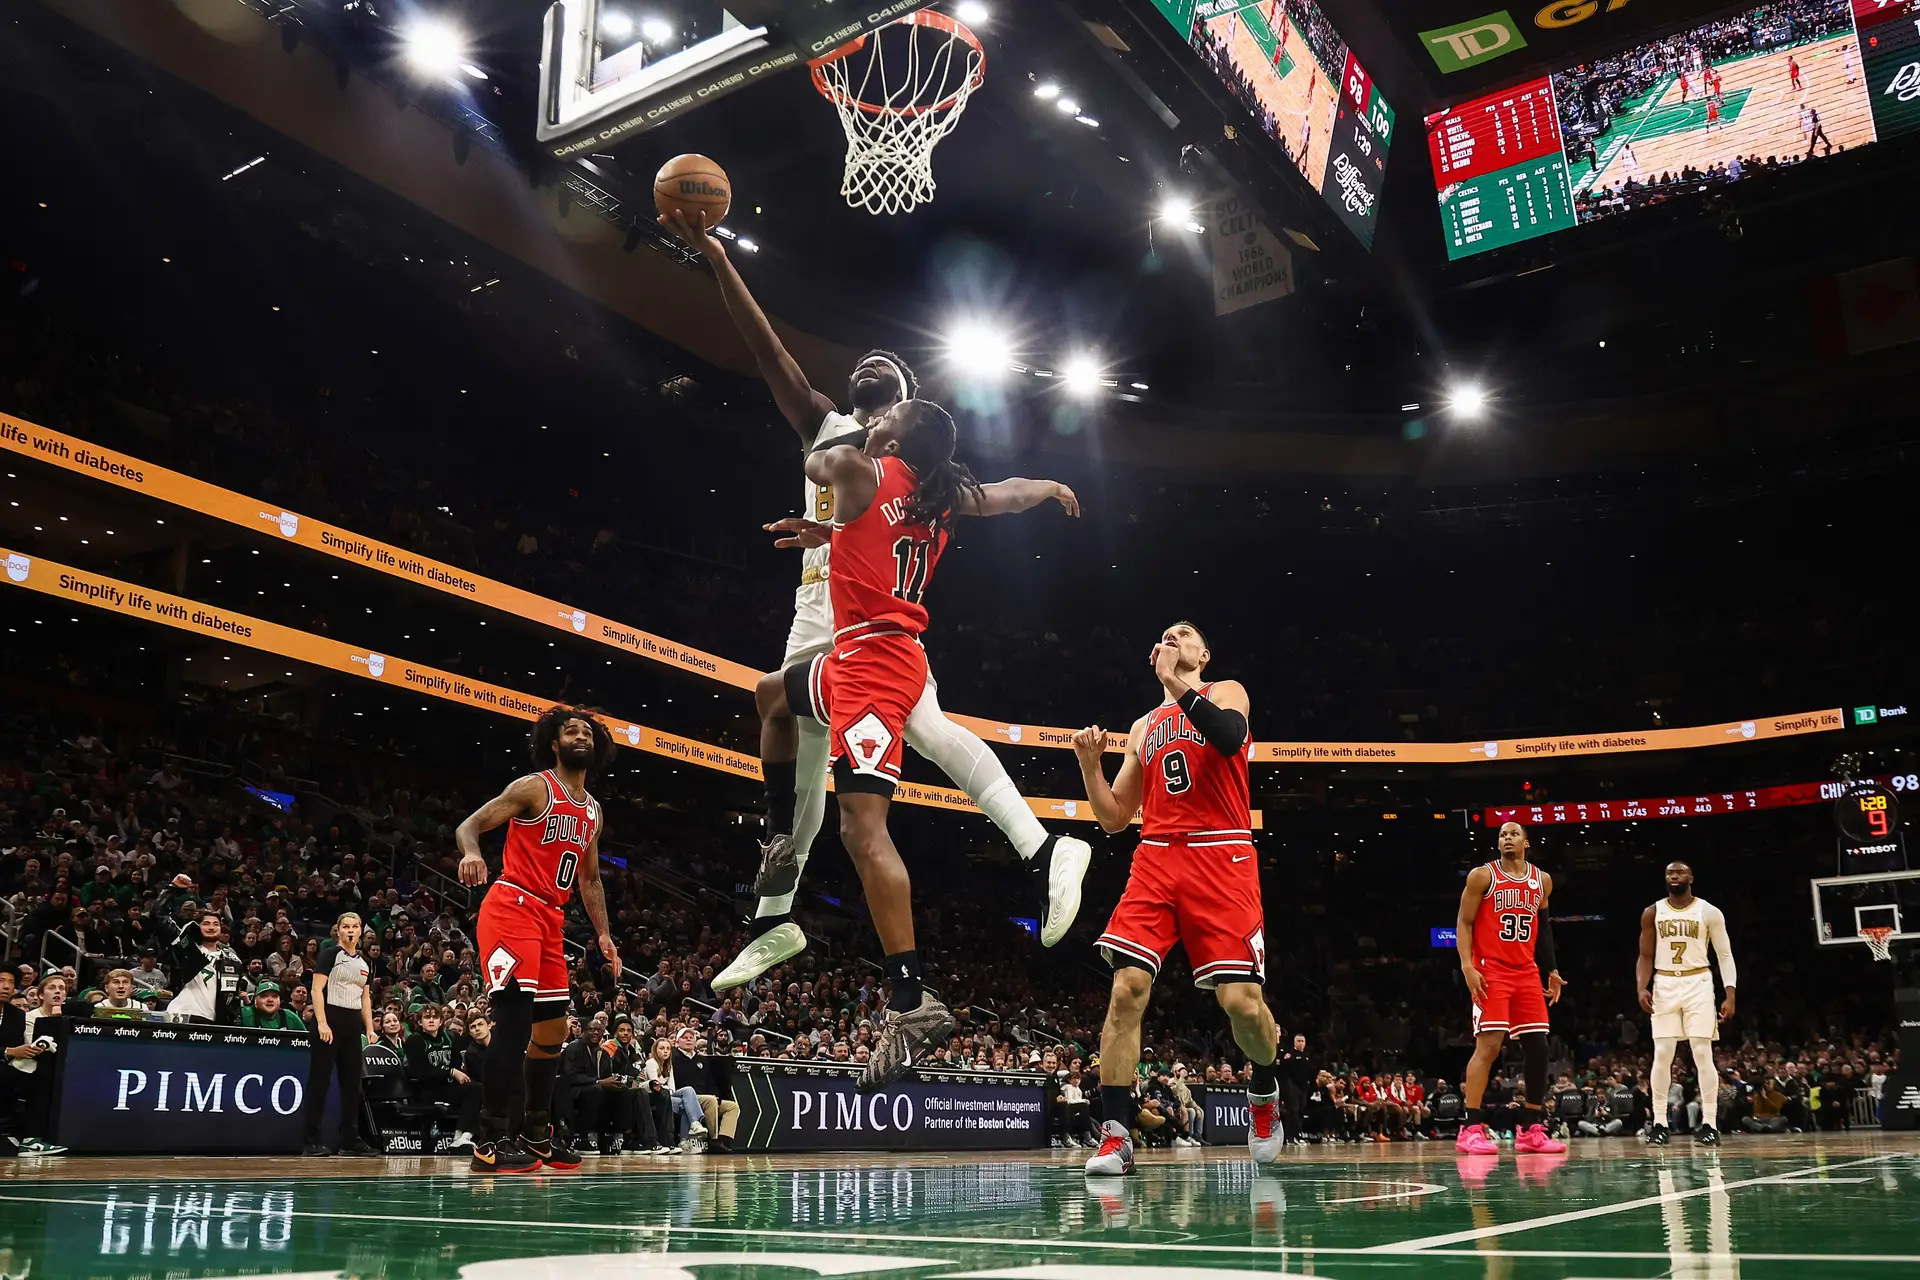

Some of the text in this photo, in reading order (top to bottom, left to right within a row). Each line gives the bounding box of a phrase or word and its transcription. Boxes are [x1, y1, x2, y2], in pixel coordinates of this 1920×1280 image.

[1431, 23, 1511, 60] TD
[1349, 75, 1364, 105] 98
[1372, 104, 1390, 138] 109
[1353, 126, 1372, 157] 1:29
[1333, 152, 1375, 207] Different
[680, 181, 726, 198] Wilson
[1341, 184, 1367, 216] Here
[1232, 257, 1273, 282] WORLD
[1220, 267, 1288, 300] CHAMPIONS
[0, 422, 144, 483] life with diabetes
[321, 531, 372, 562] Simplify
[376, 548, 396, 567] life
[398, 559, 424, 576] with
[427, 567, 476, 593] diabetes
[892, 535, 930, 605] 11
[58, 574, 252, 638] Simplify life with diabetes
[602, 625, 641, 650] Simplify
[642, 638, 657, 653] life
[658, 647, 678, 660] with
[679, 651, 717, 673] diabetes
[404, 668, 452, 694] Simplify
[453, 681, 471, 697] life
[473, 689, 497, 704] with
[1856, 705, 1908, 722] TD Bank
[1774, 716, 1818, 732] Simplify
[1820, 714, 1839, 726] life
[1038, 731, 1072, 745] Simplif
[1515, 736, 1647, 755] Simplify life with diabetes
[655, 736, 690, 757] Simplify
[691, 746, 705, 759] life
[706, 753, 724, 765] with
[725, 755, 759, 774] diabetes
[1271, 745, 1396, 760] Simplify life with diabetes
[1162, 750, 1191, 795] 9
[1891, 774, 1920, 792] 98
[908, 787, 922, 799] life
[923, 790, 943, 802] with
[1749, 799, 1756, 808] 2
[1600, 810, 1611, 819] 11
[1622, 808, 1648, 818] 15/45
[1659, 806, 1685, 816] 37/84
[1694, 804, 1712, 813] 44.0
[1727, 801, 1733, 810] 2
[1532, 814, 1543, 822] 45
[1554, 813, 1566, 822] 24
[1581, 811, 1587, 820] 2
[1868, 810, 1888, 836] 9
[1859, 844, 1898, 855] TISSOT
[555, 850, 578, 891] 0
[1498, 913, 1533, 942] 35
[1657, 919, 1699, 939] BOSTON
[1670, 941, 1687, 964] 7
[74, 1025, 102, 1036] xfinity
[114, 1027, 140, 1037] xfinity
[152, 1029, 177, 1040] xfinity
[188, 1032, 213, 1042] xfinity
[224, 1034, 247, 1044] xfinity
[257, 1036, 280, 1046] xfinity
[291, 1038, 310, 1048] xfinit
[365, 1056, 399, 1067] PIMCO
[113, 1069, 303, 1115] PIMCO
[791, 1091, 914, 1131] PIMCO
[924, 1097, 1041, 1114] Official Investment Management
[924, 1116, 1030, 1129] Partner of the Boston Celtics
[1215, 1106, 1249, 1127] PIMC
